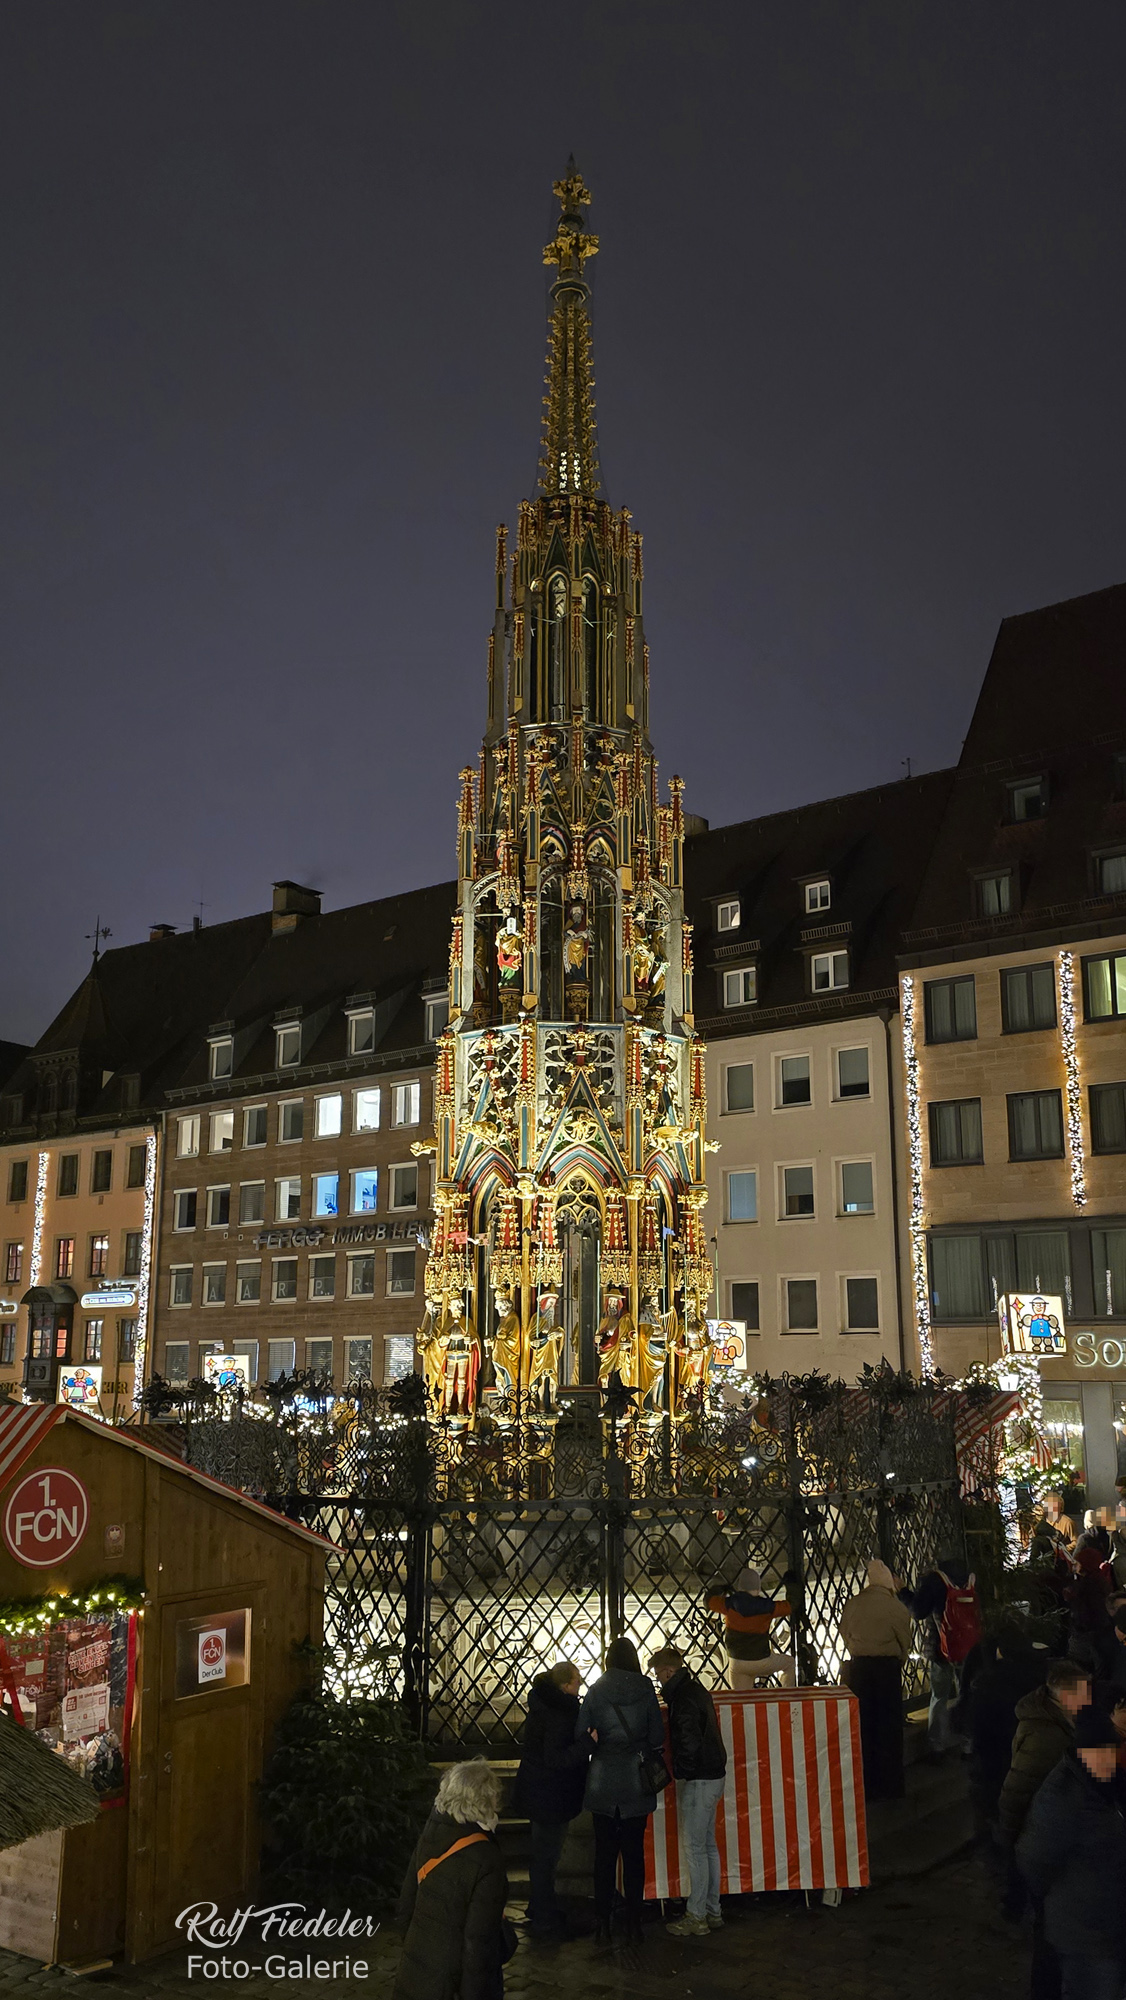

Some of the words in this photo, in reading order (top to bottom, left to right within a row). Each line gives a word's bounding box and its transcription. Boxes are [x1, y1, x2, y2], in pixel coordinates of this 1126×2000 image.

[38, 1476, 56, 1507] 1.
[15, 1506, 78, 1545] FCN
[203, 1646, 221, 1660] FCN
[211, 1667, 223, 1676] Club
